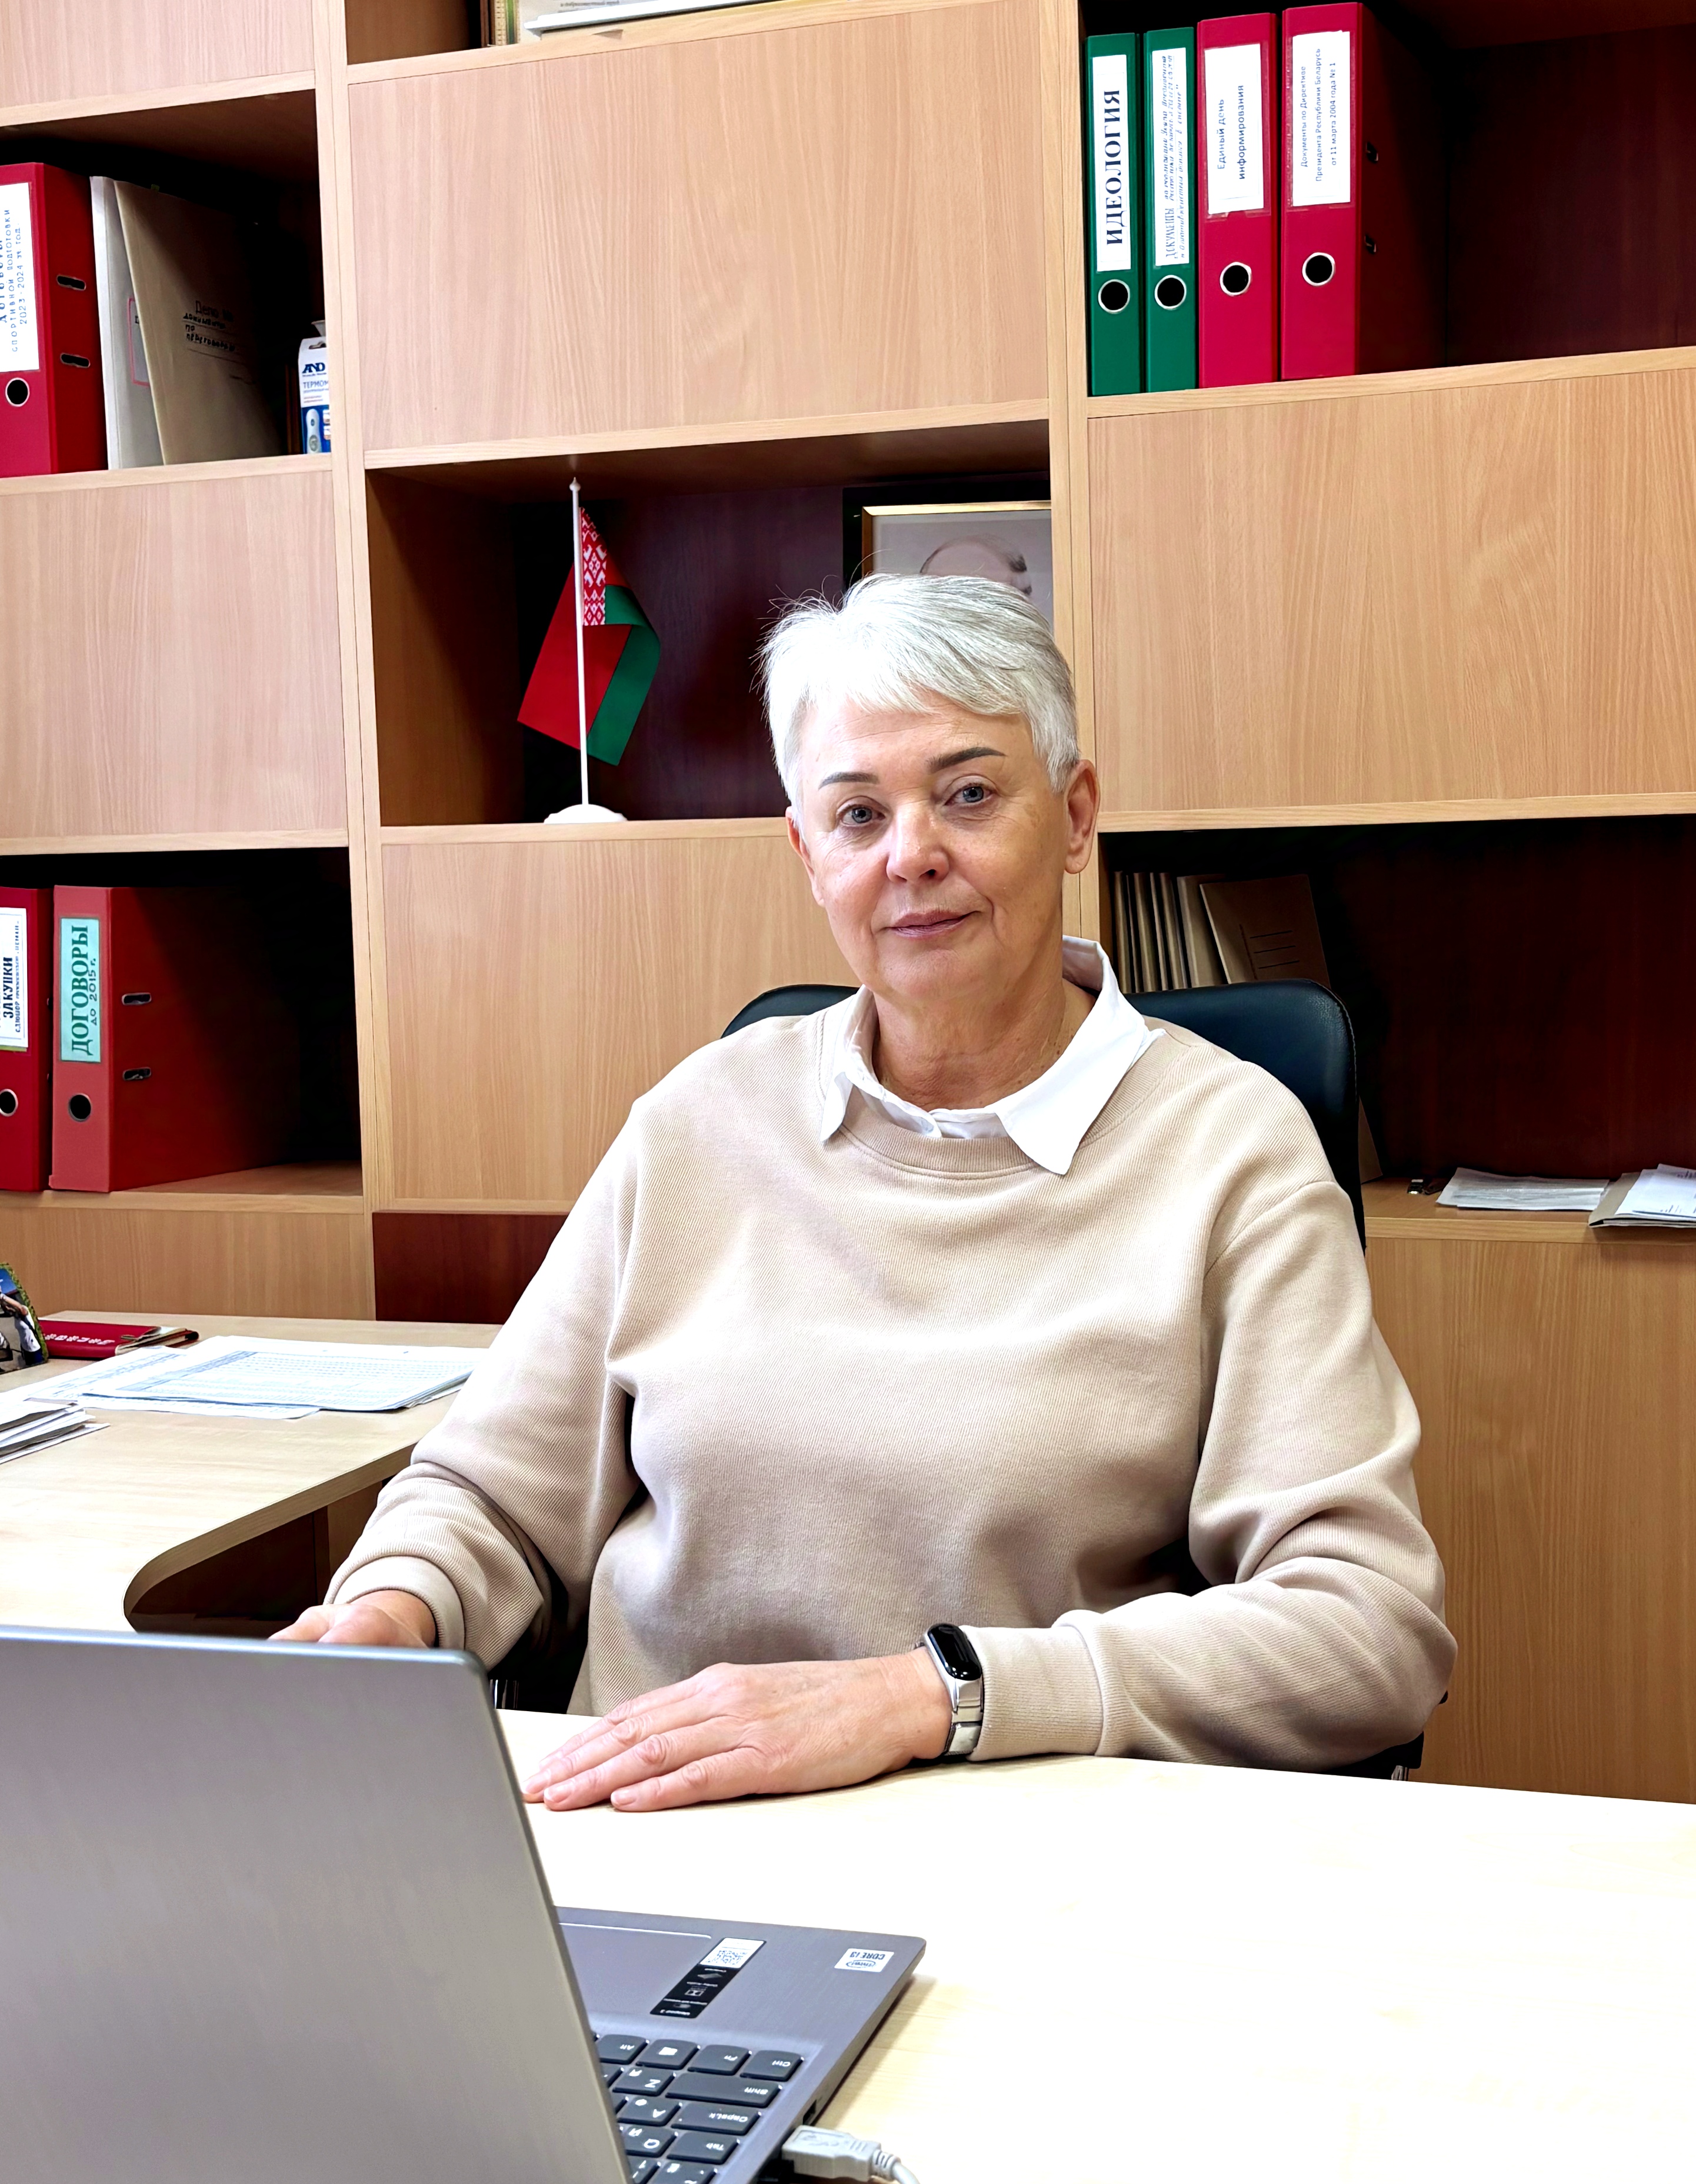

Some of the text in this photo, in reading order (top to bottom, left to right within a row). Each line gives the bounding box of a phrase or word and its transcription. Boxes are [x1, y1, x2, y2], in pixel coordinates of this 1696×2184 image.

[1314, 48, 1322, 85] Беларусь
[1329, 69, 1336, 78] №
[1300, 66, 1308, 109] Директиве
[1314, 87, 1323, 134] Республики
[1216, 99, 1227, 169] Единый день
[1237, 85, 1247, 180] информирования
[1300, 122, 1308, 168] Документы
[1330, 146, 1337, 155] 11
[1104, 90, 1127, 245] ИДЕОЛОГИЯ
[1331, 158, 1337, 166] от
[1165, 208, 1178, 259] ДОКУМЕНТЫ
[4, 210, 18, 352] СПОРТИВНОЙ ПОДГОТОВКИ
[302, 362, 325, 374] AND
[2, 957, 14, 1019] ЗАКУПКИ
[72, 925, 93, 1056] ДОГОВОРЫ
[89, 970, 97, 1002] 2015
[860, 1952, 885, 1960] CORE
[645, 2079, 661, 2088] Z
[744, 2086, 768, 2095] Shift
[644, 2138, 660, 2149] Q
[705, 2142, 725, 2151] Tab
